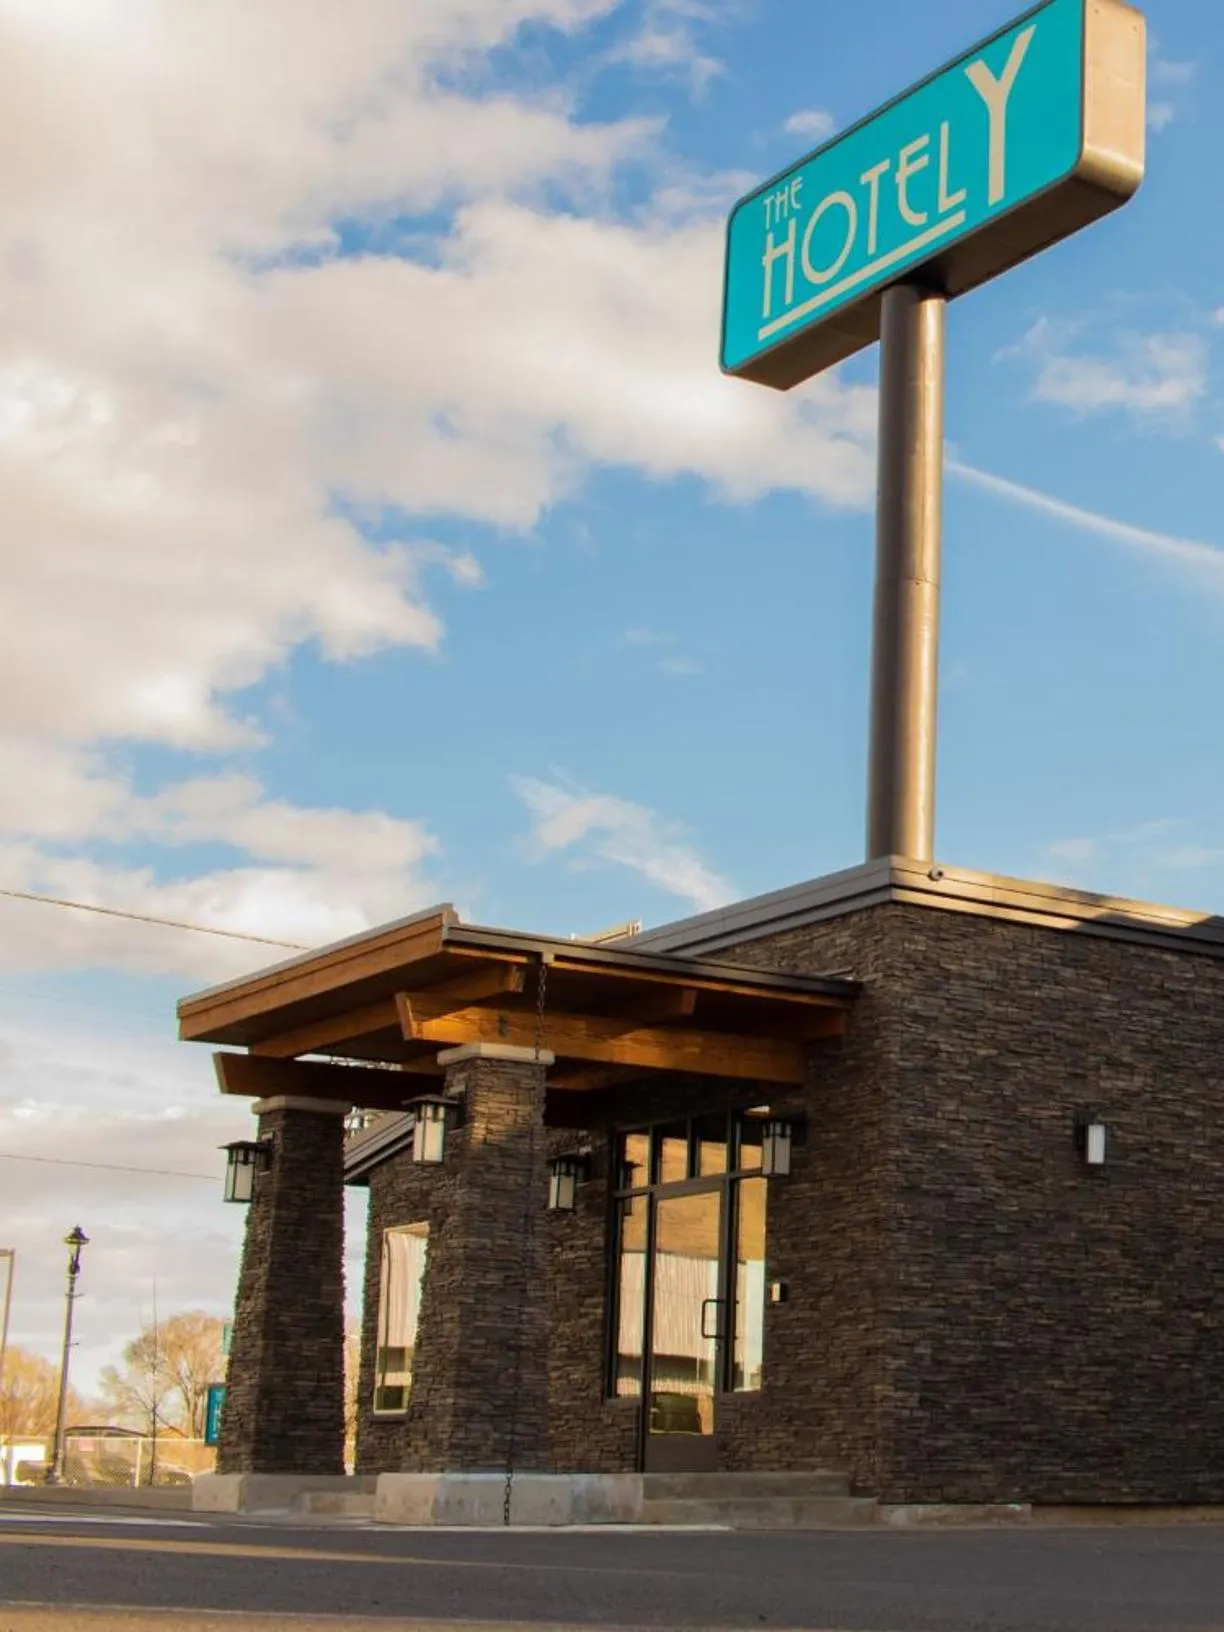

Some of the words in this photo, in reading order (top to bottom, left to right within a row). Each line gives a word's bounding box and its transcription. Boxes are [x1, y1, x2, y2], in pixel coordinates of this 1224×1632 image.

[762, 120, 967, 319] HOTEL
[964, 24, 1037, 207] Y
[763, 177, 803, 230] THE
